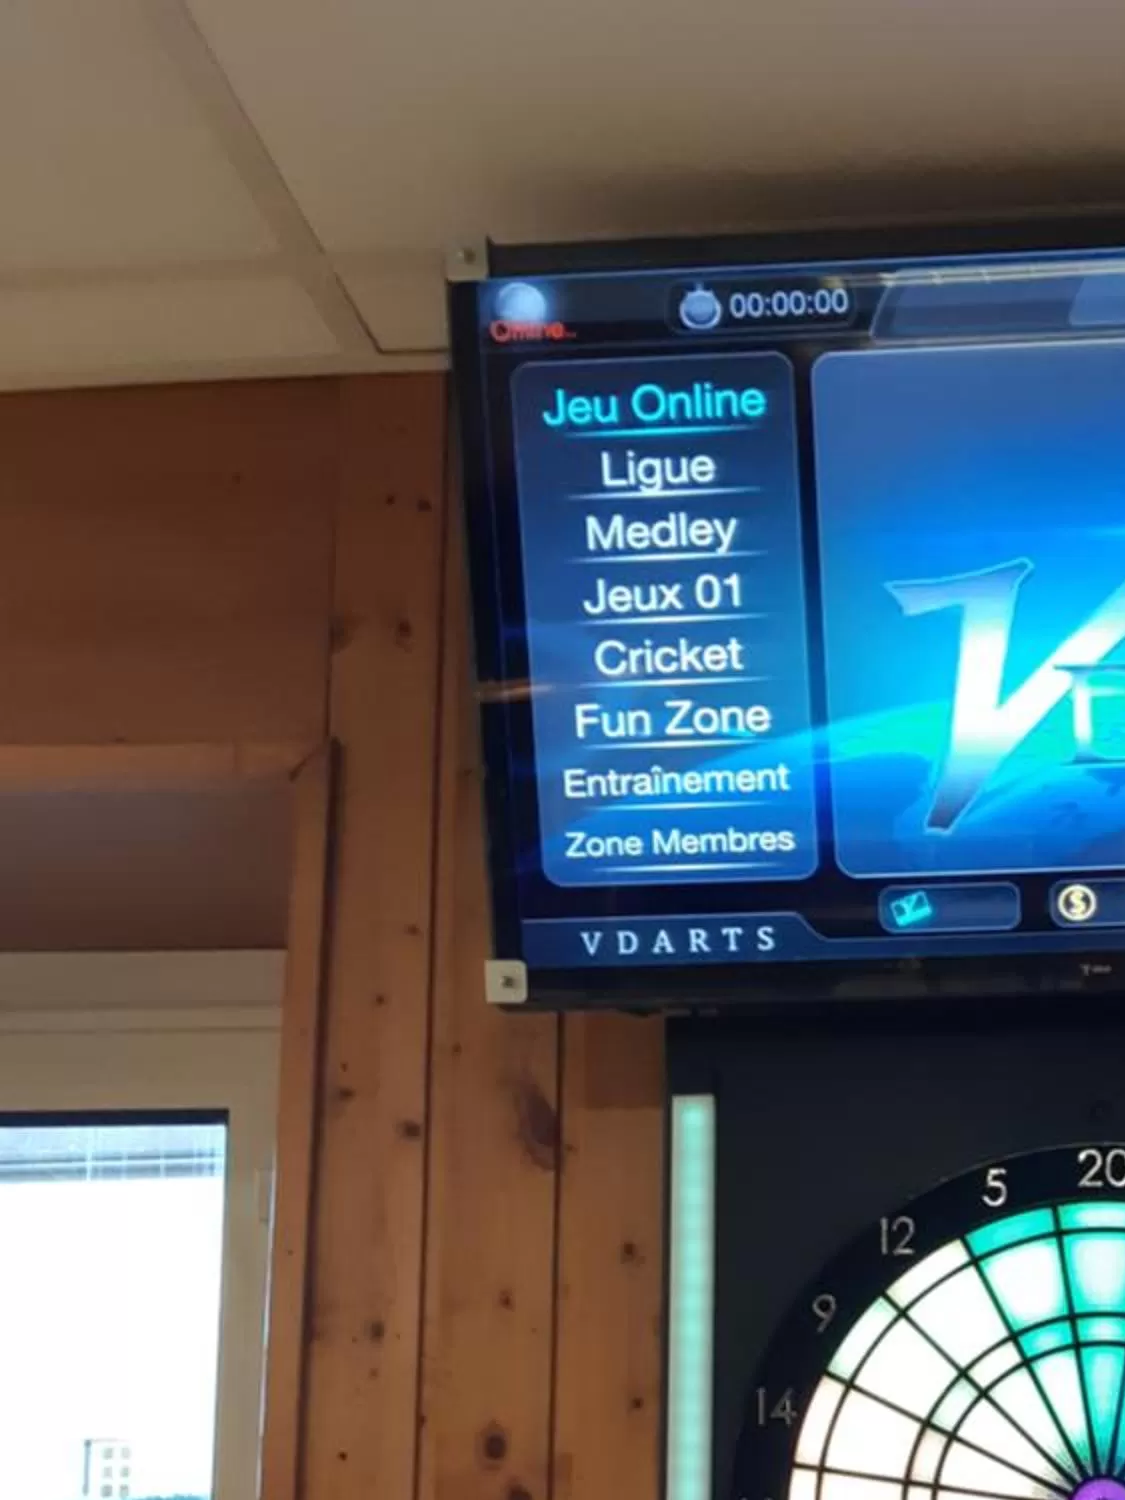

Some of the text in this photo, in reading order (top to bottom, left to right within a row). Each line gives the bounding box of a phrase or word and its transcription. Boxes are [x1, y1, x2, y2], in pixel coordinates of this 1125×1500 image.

[729, 287, 849, 319] 00:00:00
[541, 382, 768, 428] Jeu Online
[600, 450, 717, 493] Ligue
[585, 512, 738, 554] Medley
[582, 573, 743, 616] Jeux 01
[593, 638, 745, 677] Cricket
[574, 699, 772, 739] Fun Zone
[562, 763, 791, 799] Entraînement
[564, 827, 796, 859] Zone Membres
[579, 925, 777, 956] VDARTS
[981, 1168, 1008, 1207] 5
[879, 1216, 916, 1256] 12
[811, 1294, 838, 1332] 9
[755, 1386, 798, 1426] 14
